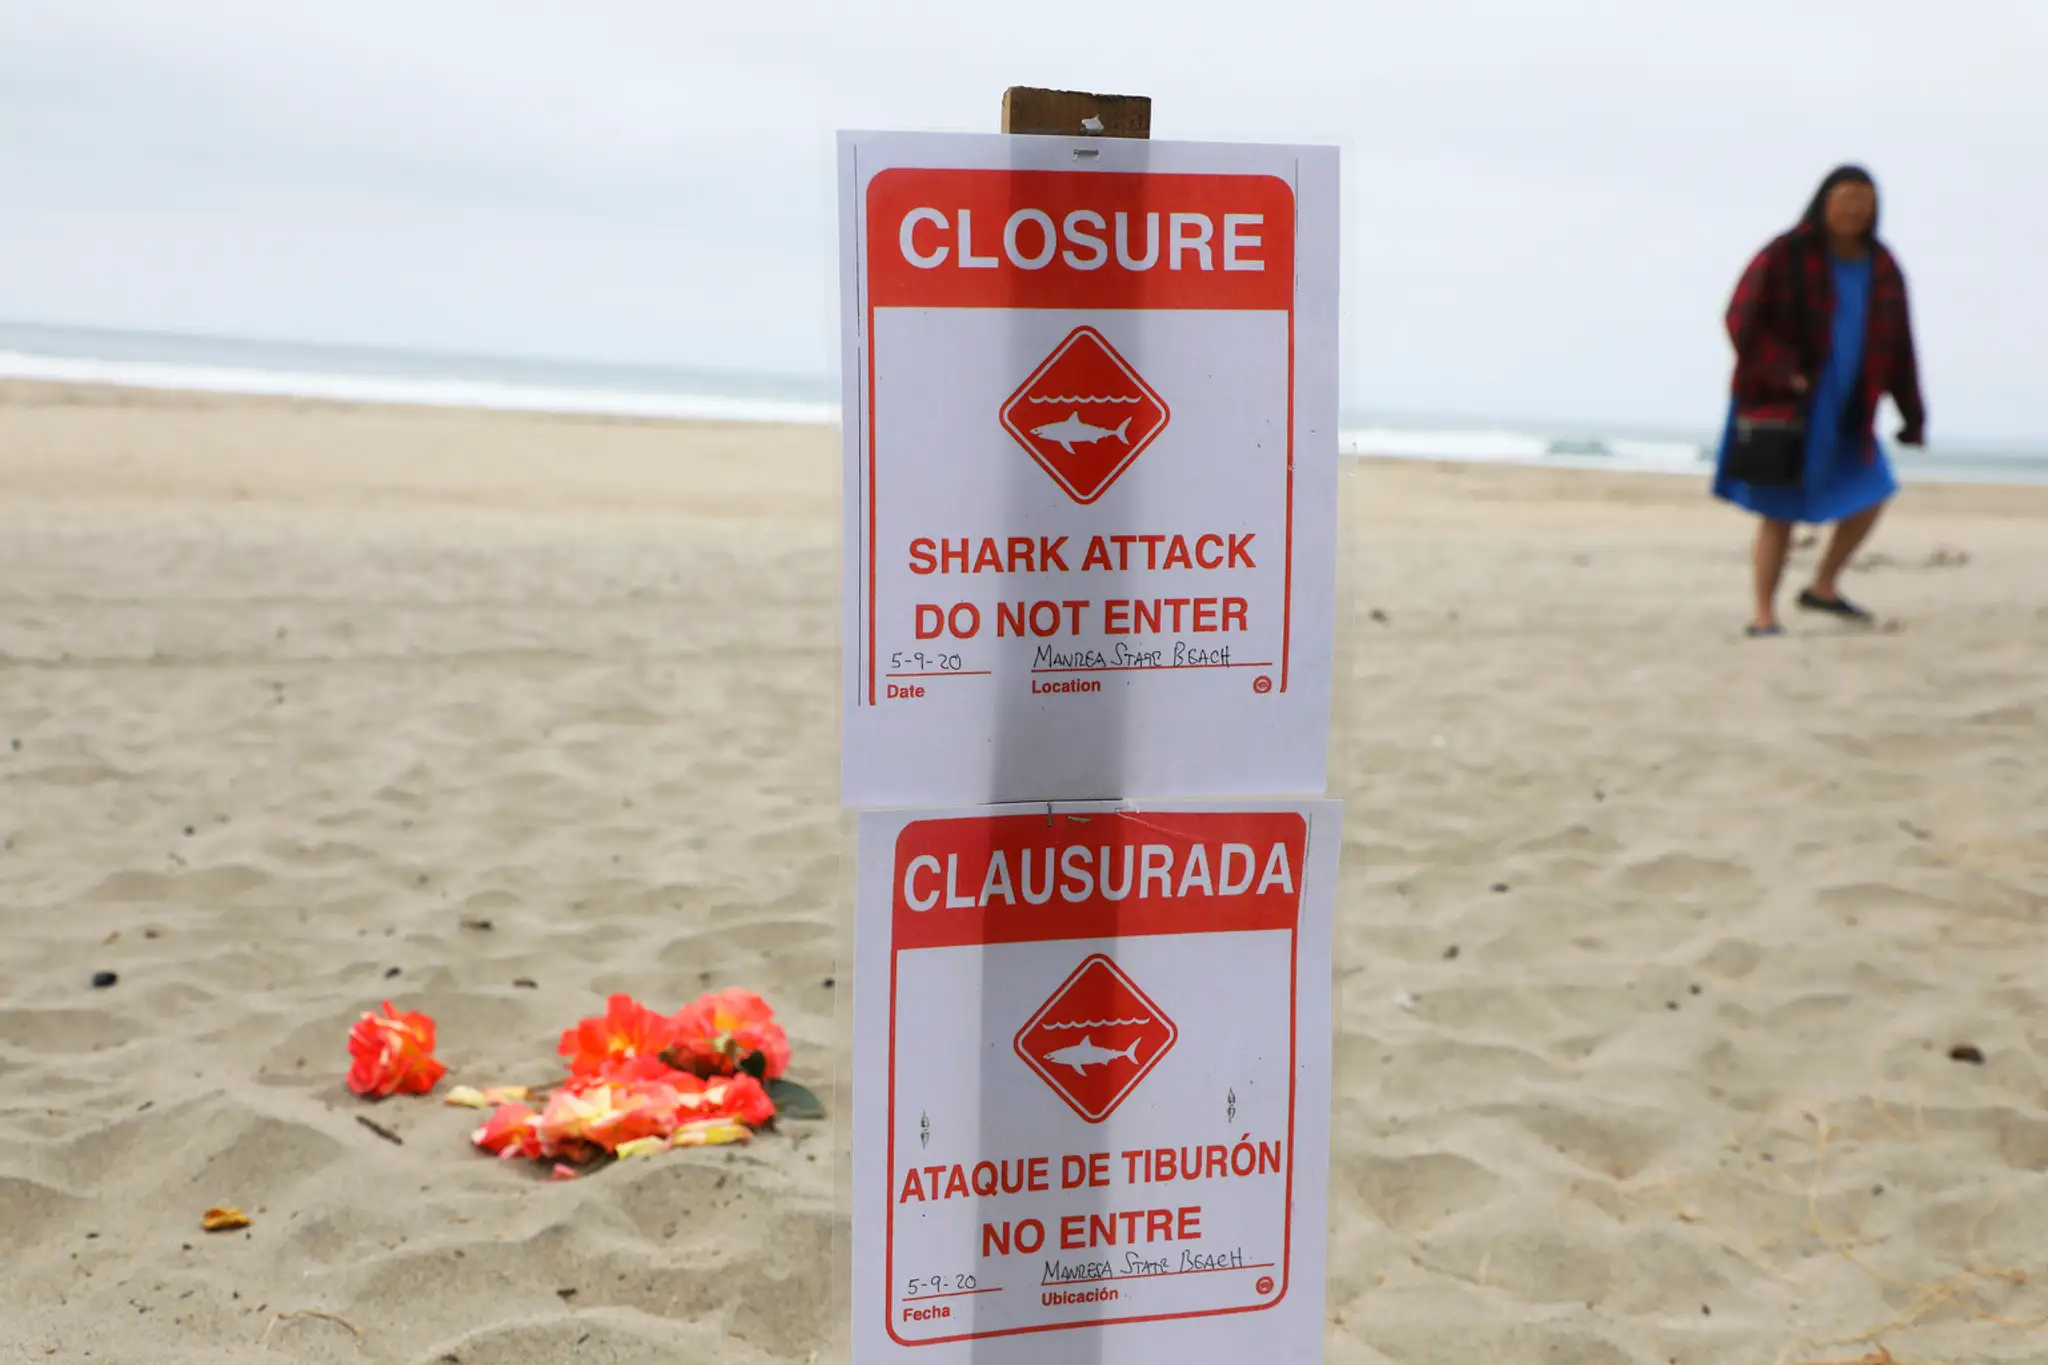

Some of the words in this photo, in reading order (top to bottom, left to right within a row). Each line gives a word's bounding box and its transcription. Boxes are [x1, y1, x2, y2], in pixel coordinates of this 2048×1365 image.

[899, 207, 1265, 271] CLOSURE
[909, 536, 1069, 575] SHARK
[1082, 533, 1256, 572] ATTACK
[915, 602, 980, 640] DO
[997, 600, 1090, 638] NOT
[1104, 597, 1248, 636] ENTER
[891, 652, 962, 670] 5-9-20
[1173, 641, 1231, 668] BEACH
[887, 684, 925, 698] Date
[1031, 679, 1101, 694] Location
[903, 842, 1294, 912] CLAUSURADA
[900, 1157, 1048, 1203] ATAQUE
[1061, 1152, 1110, 1189] DE
[1121, 1133, 1281, 1184] TIBURÓN
[982, 1218, 1045, 1257] NO
[1060, 1206, 1202, 1249] ENTRE
[1179, 1247, 1243, 1273] BEACH
[907, 1274, 977, 1295] 5-9-20
[1041, 1287, 1119, 1306] Ubicación
[903, 1305, 951, 1322] Fecha
